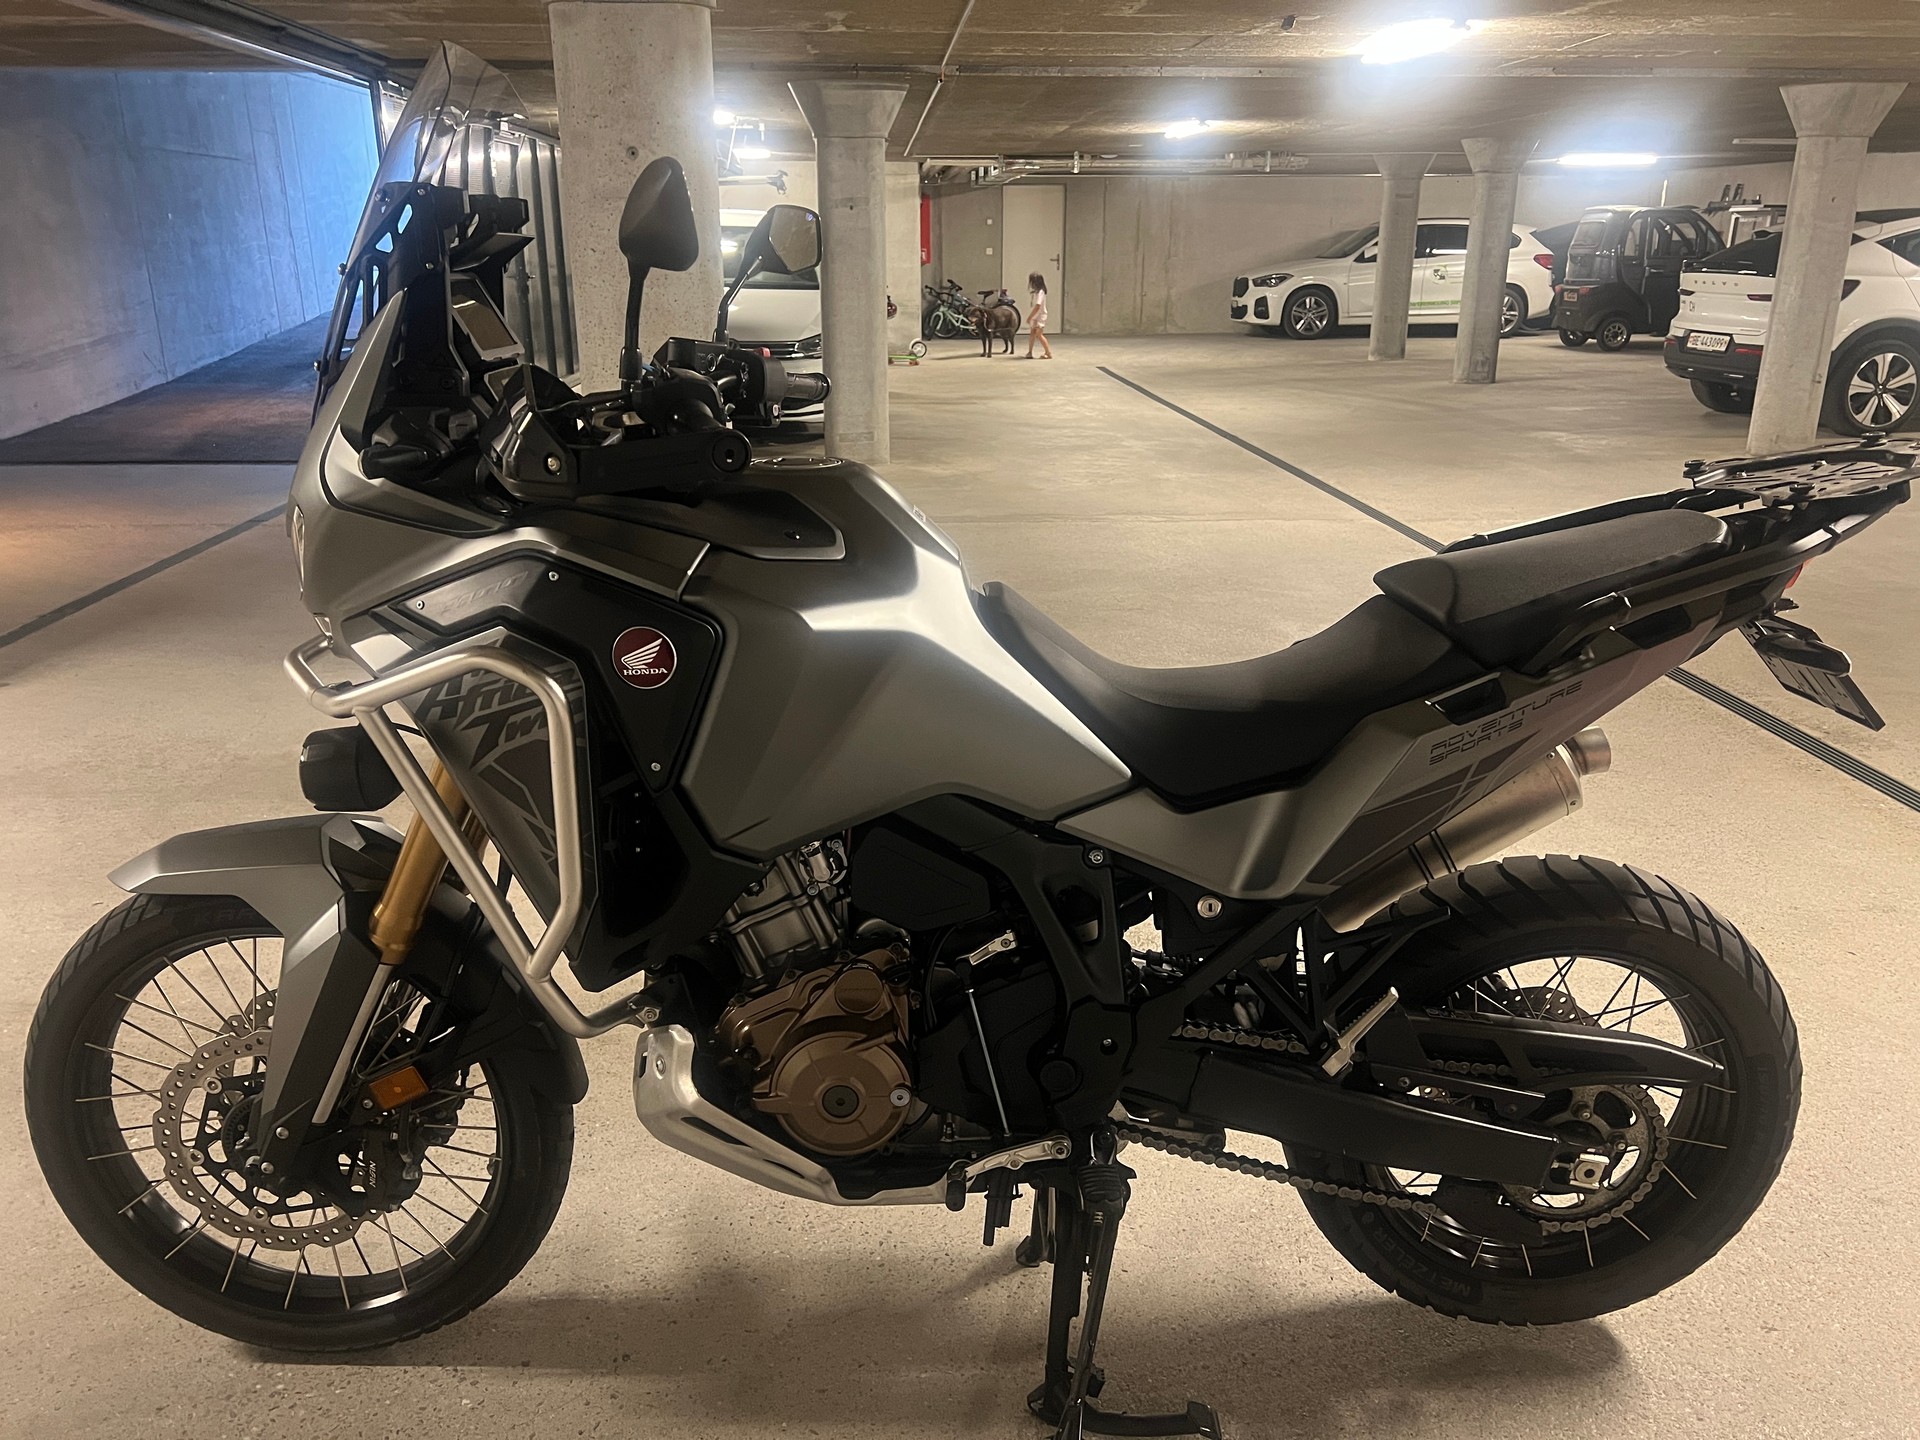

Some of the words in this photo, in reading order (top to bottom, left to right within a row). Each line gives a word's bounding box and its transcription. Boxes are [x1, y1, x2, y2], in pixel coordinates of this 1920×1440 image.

[623, 667, 668, 676] HONDA
[1429, 718, 1524, 766] SPORTS
[1430, 680, 1583, 754] ADVENTURE
[1373, 1228, 1471, 1297] METZELER
